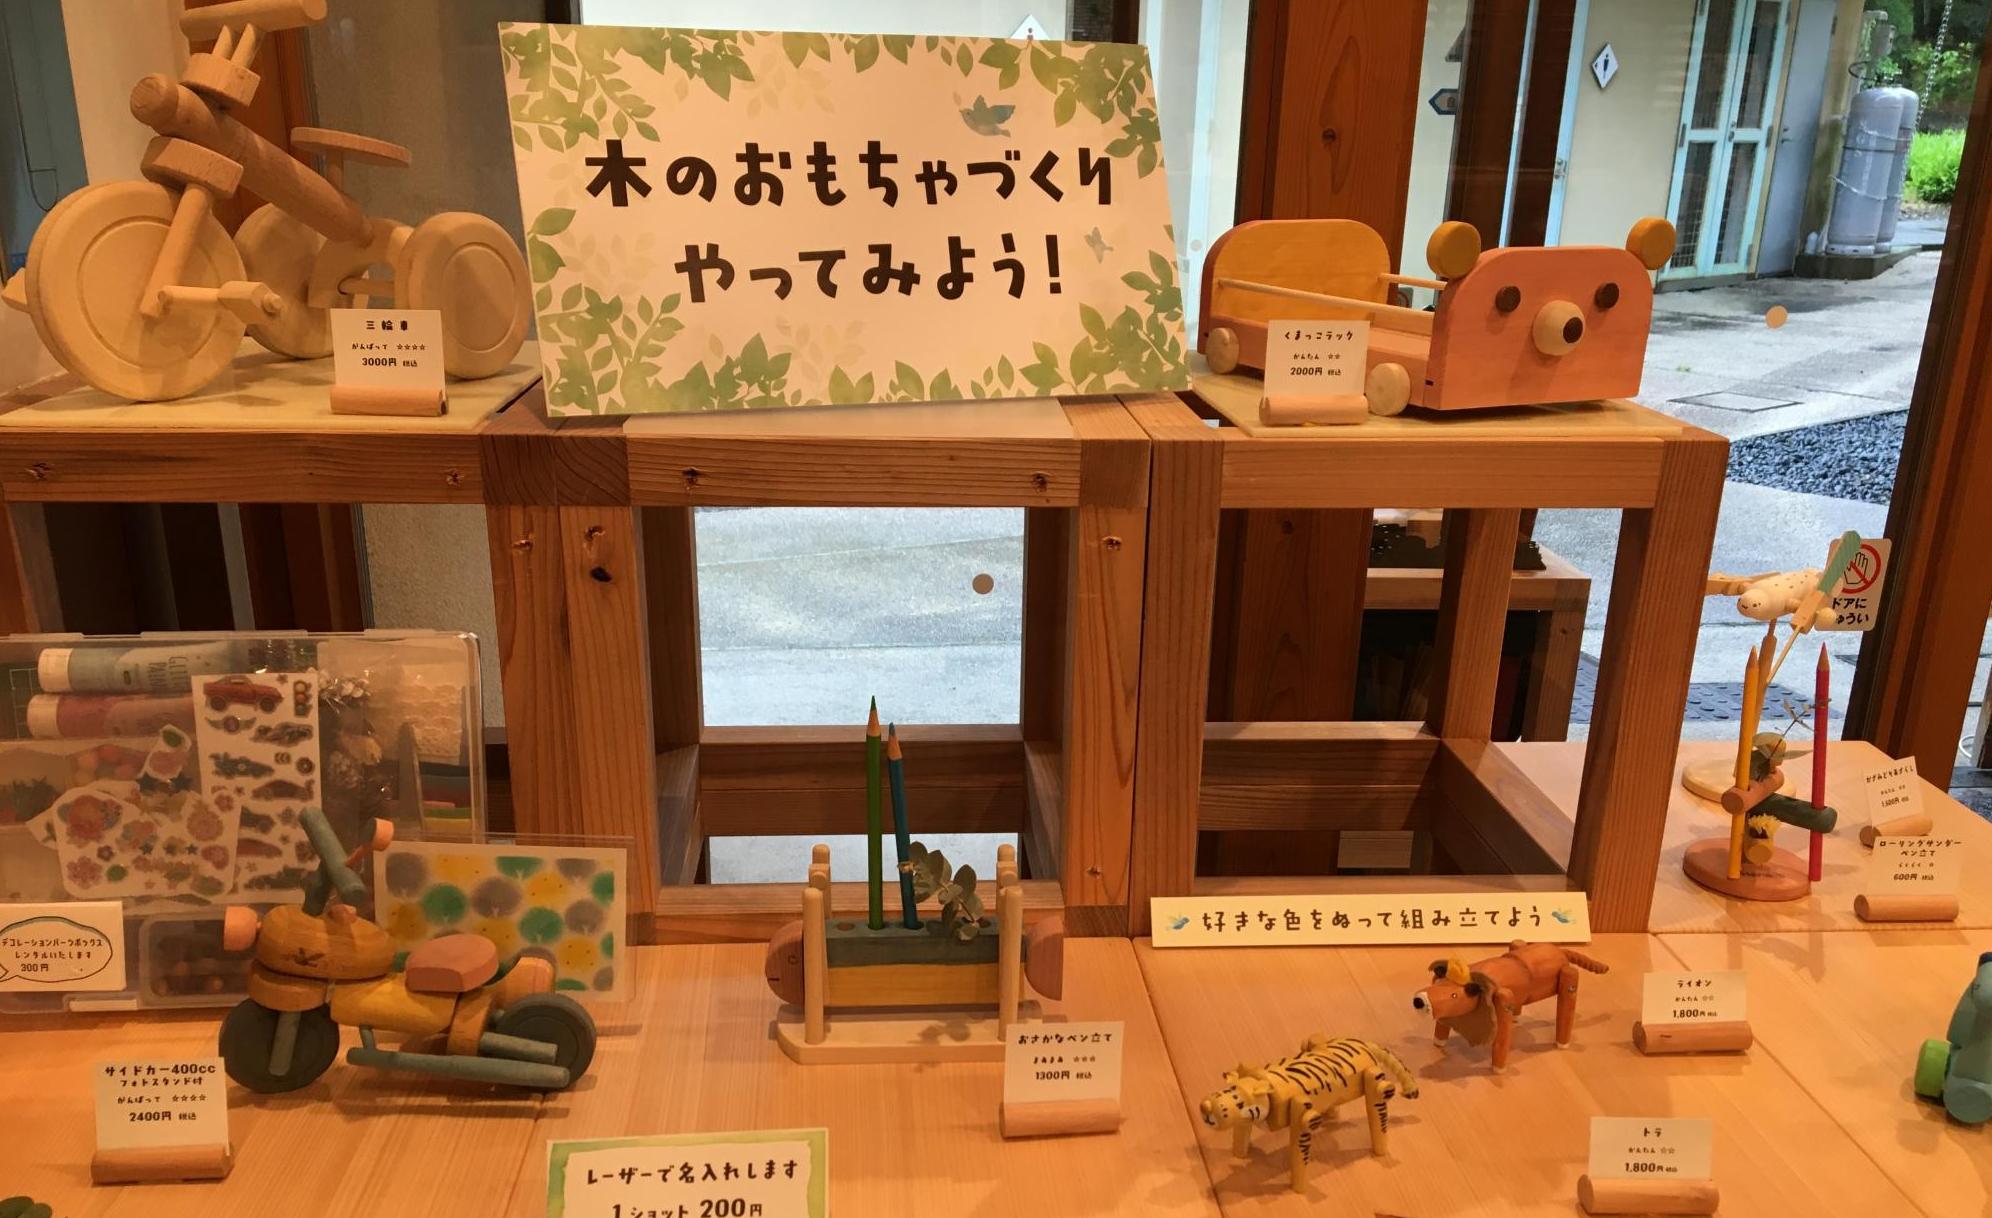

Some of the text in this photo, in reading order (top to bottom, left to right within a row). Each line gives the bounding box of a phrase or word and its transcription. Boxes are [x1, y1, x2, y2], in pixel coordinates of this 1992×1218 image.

[584, 139, 1112, 208] 木のおもちゃづくり
[674, 232, 1062, 303] やってみよう！
[1285, 330, 1352, 340] くまっこラック
[362, 358, 396, 366] 3000円
[1291, 367, 1322, 375] 2000円
[1202, 906, 1540, 932] 好きな色をぬって組み立てよう
[1678, 979, 1711, 988] ライオン
[1019, 1033, 1111, 1044] おさかなペン立て
[105, 1064, 216, 1076] サイドカー400cc
[129, 1111, 171, 1121] 2400円
[1644, 1128, 1661, 1137] トラ
[588, 1160, 797, 1184] レーザーで名入れします
